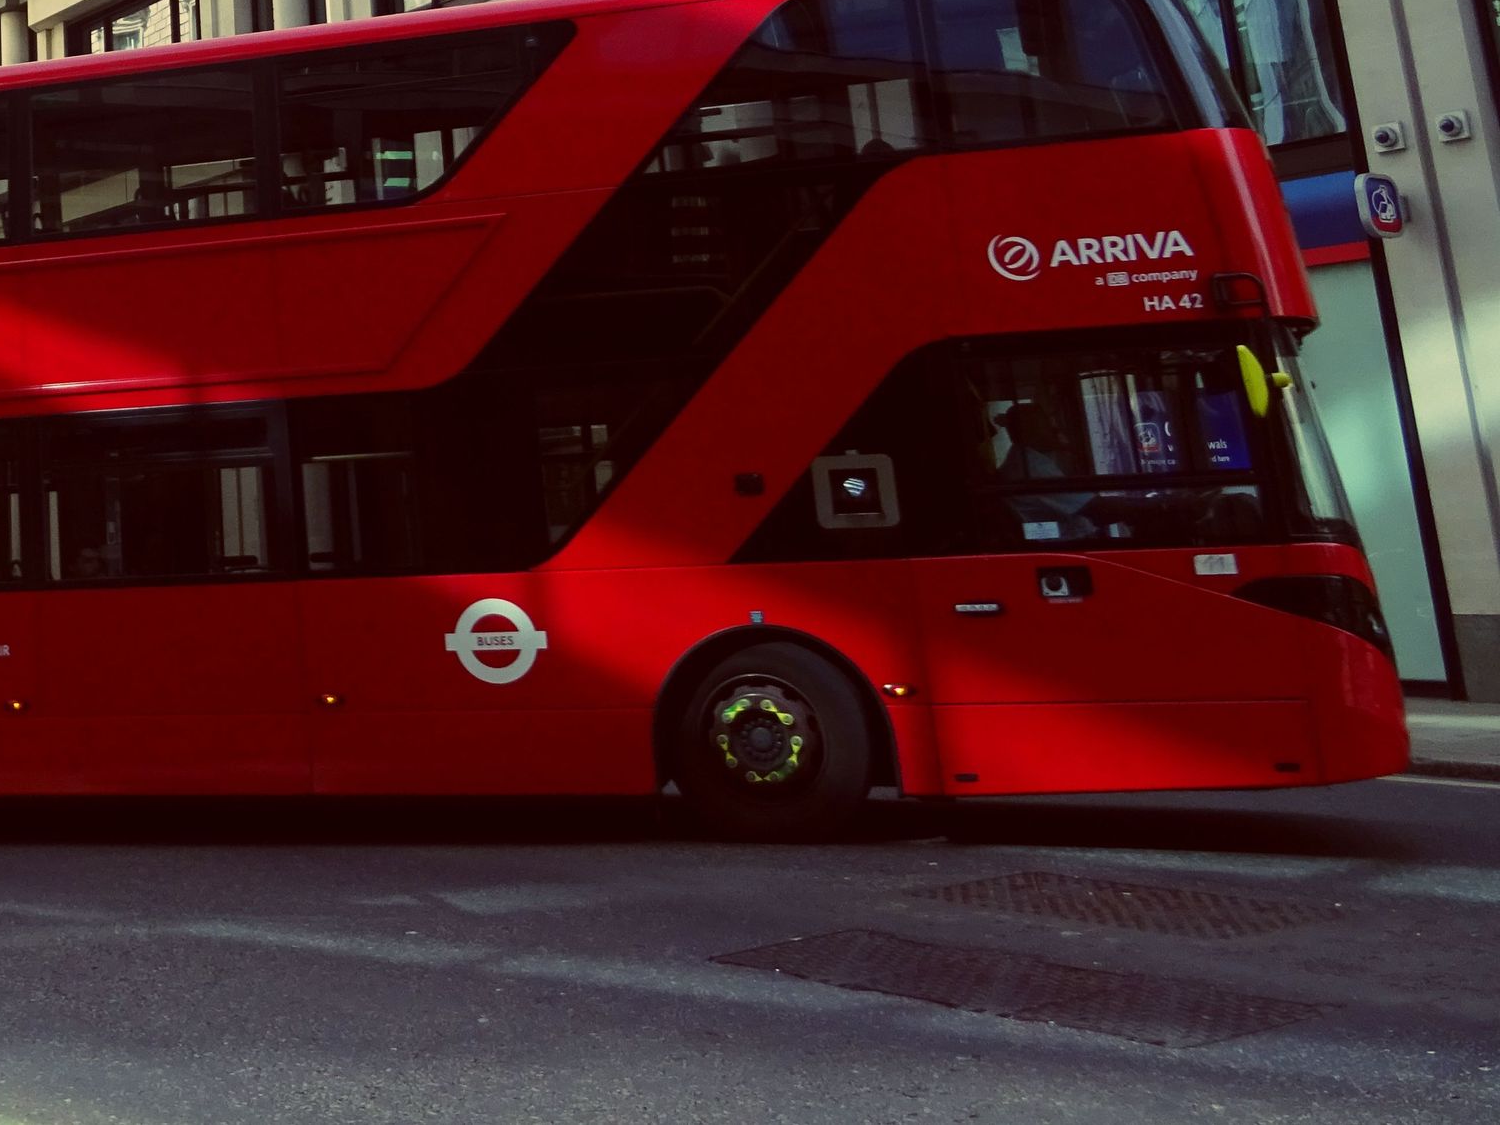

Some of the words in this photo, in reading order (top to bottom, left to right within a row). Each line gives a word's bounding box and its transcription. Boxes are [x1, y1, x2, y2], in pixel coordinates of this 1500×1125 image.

[1050, 230, 1195, 267] ARRIVA
[1095, 276, 1105, 286] a
[1131, 269, 1198, 283] company
[1143, 294, 1176, 312] HA
[1178, 293, 1204, 309] 42
[476, 635, 515, 646] BUSES
